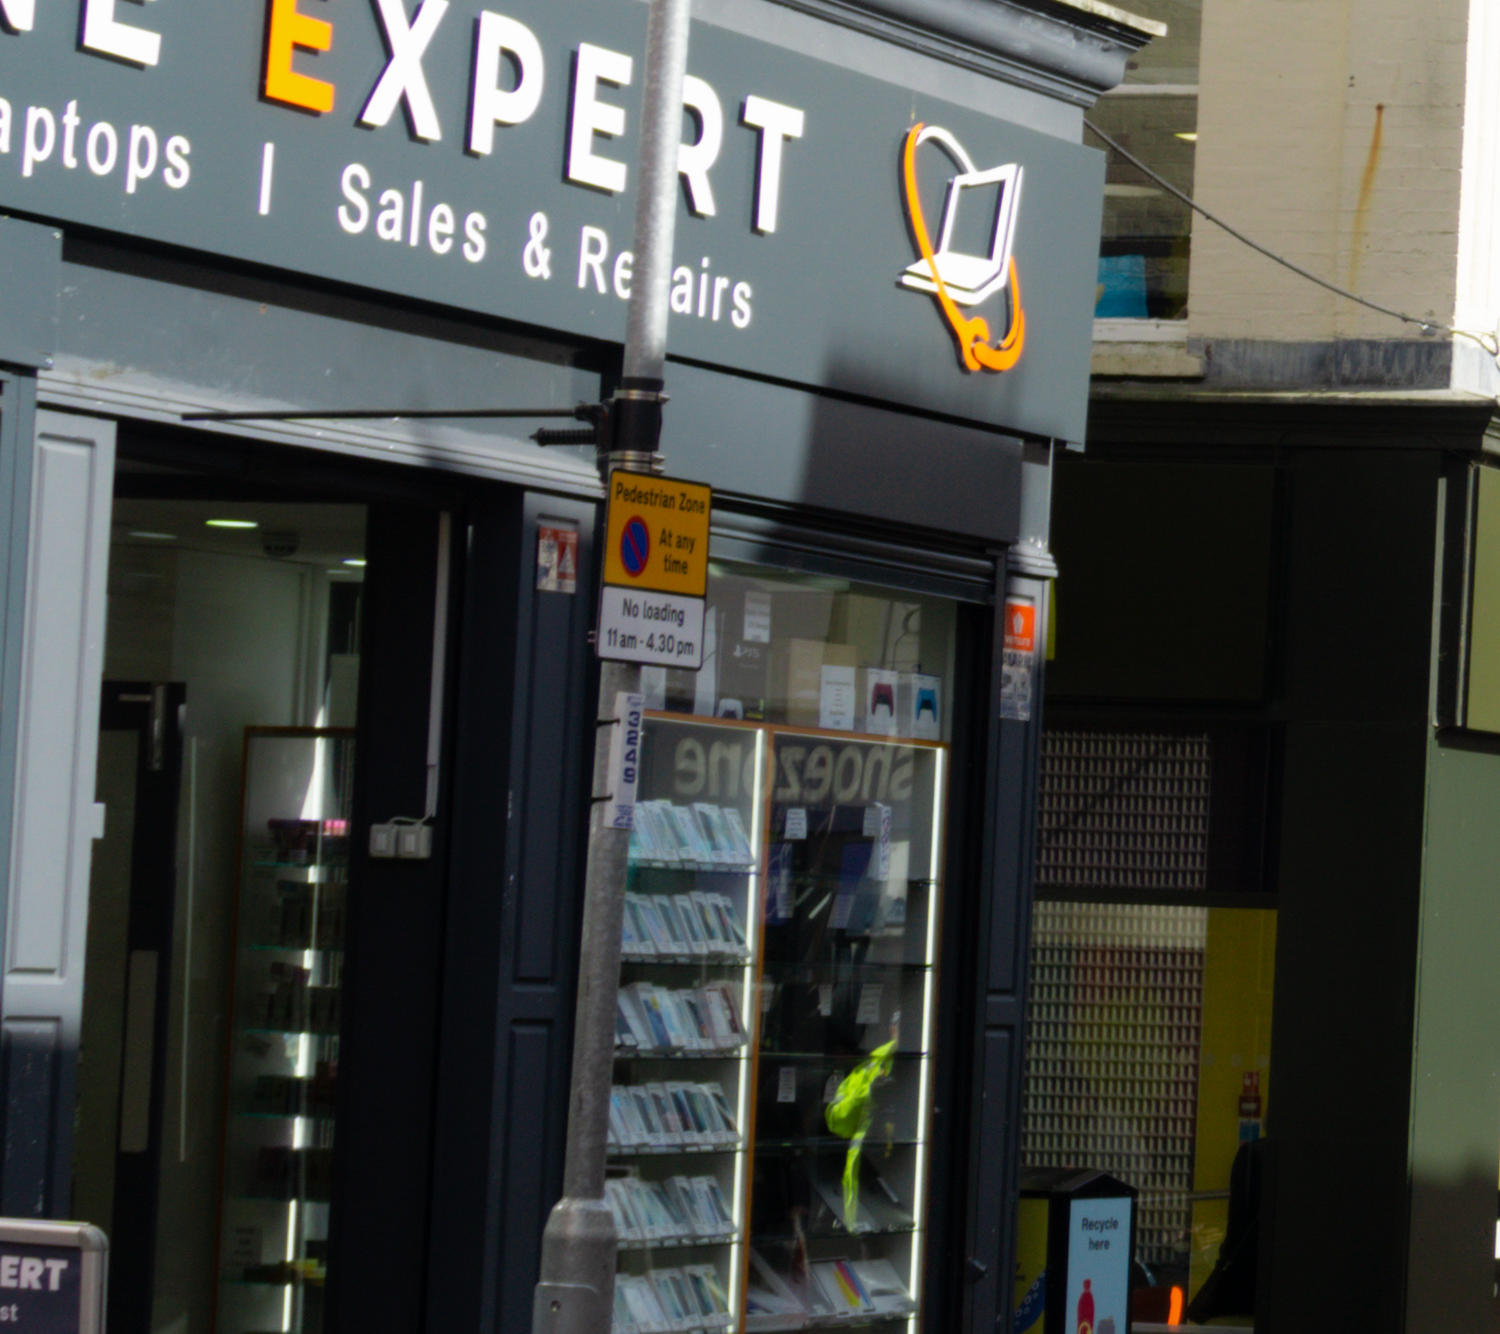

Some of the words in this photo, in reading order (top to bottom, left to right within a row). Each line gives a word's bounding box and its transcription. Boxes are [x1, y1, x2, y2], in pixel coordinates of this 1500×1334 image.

[338, 164, 487, 263] Sales
[523, 212, 551, 280] &
[578, 225, 753, 328] Reairs
[615, 482, 675, 510] Pedestrian
[679, 493, 705, 515] Zone
[659, 528, 672, 547] At
[676, 536, 695, 554] any
[664, 553, 689, 575] time
[622, 598, 638, 618] No
[643, 601, 685, 627] loading
[1082, 1217, 1119, 1233] Recycle
[1089, 1237, 1110, 1251] here
